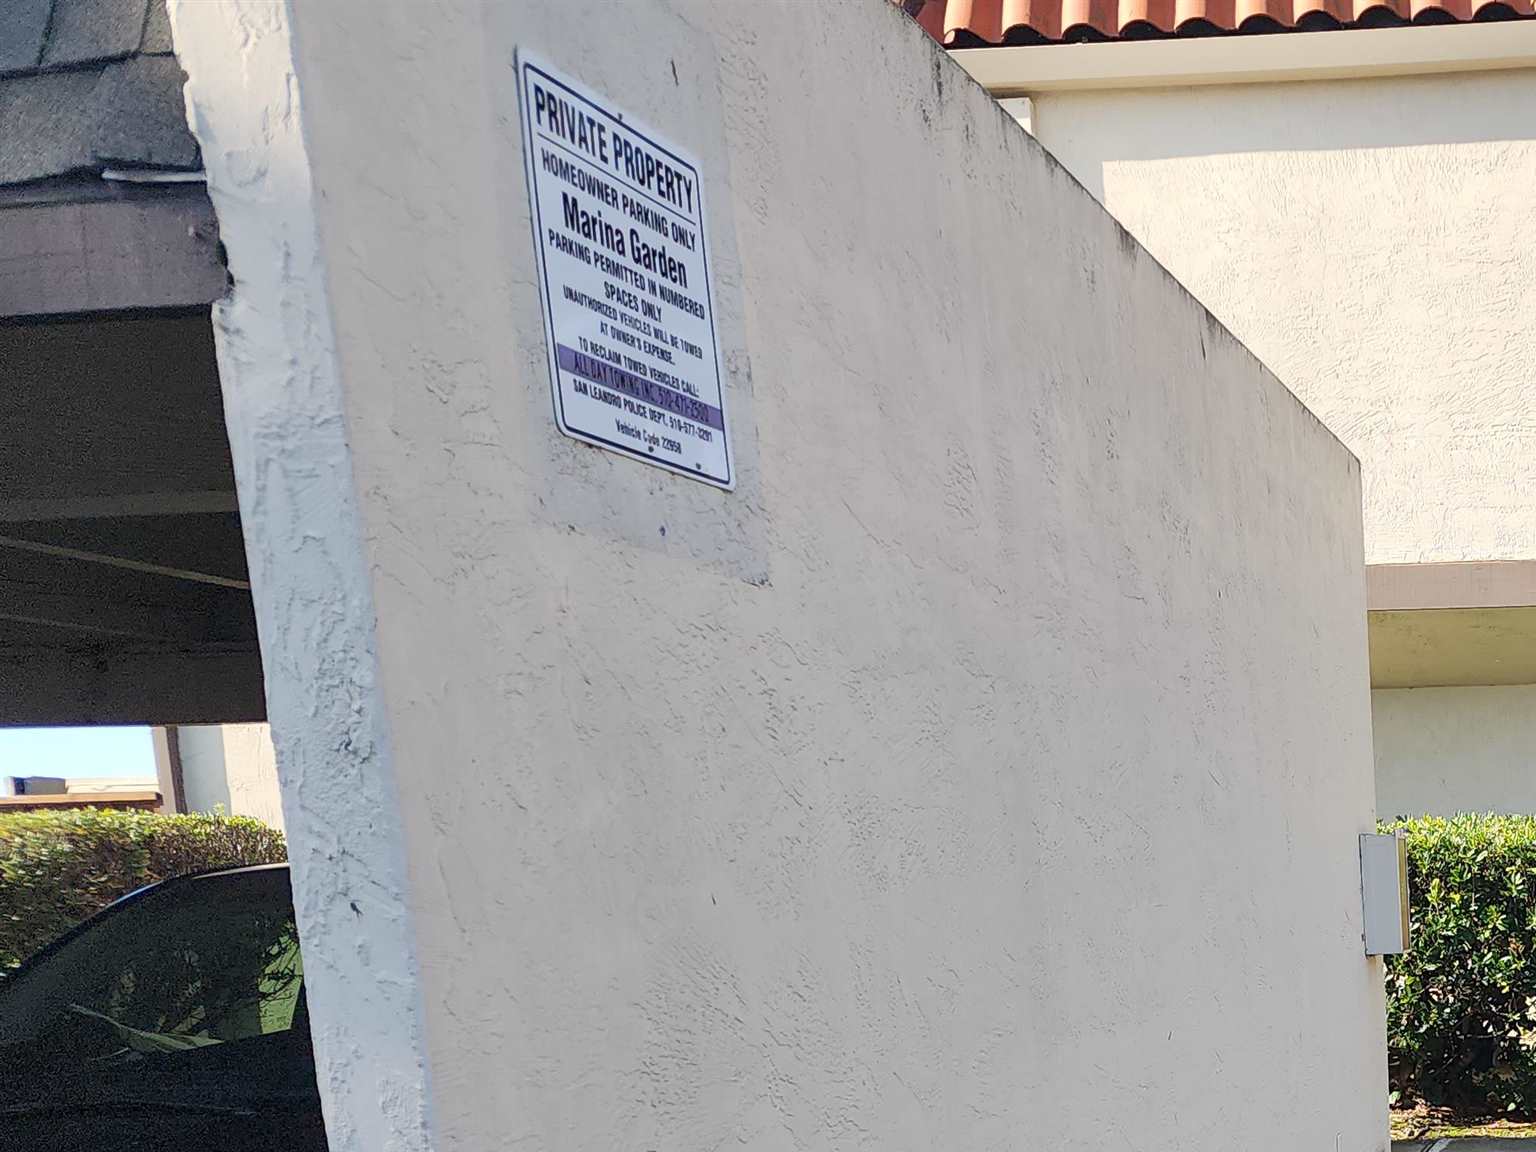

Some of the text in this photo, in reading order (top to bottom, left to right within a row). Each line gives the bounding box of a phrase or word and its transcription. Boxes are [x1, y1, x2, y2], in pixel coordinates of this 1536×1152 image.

[533, 83, 694, 215] PRIVATE PROPERTY
[541, 146, 697, 254] HOMEOWNER PARKING ONLY
[561, 190, 688, 289] Marina Garden
[548, 227, 705, 321] PARKING PERMITTED IN NUMBERED
[563, 284, 617, 321] UNAUTHORIZED
[618, 310, 651, 336] VEHICLES
[653, 326, 668, 344] WILL
[670, 334, 678, 349] BE
[603, 281, 662, 323] SPACES ONLY
[578, 335, 588, 352] TO
[589, 340, 621, 366] RECLAIM
[623, 355, 647, 376] TOWED
[648, 365, 680, 390] VEHICLES
[599, 320, 608, 336] AT
[610, 325, 641, 351] OWNER'S
[572, 378, 588, 396] SAN
[589, 384, 620, 408] LEANDRO
[623, 397, 647, 419] POLICE
[573, 351, 587, 375] ALL
[590, 358, 607, 383] DAY
[609, 366, 639, 395] TOWING
[615, 419, 641, 440] Vehicle
[642, 429, 659, 446] Code
